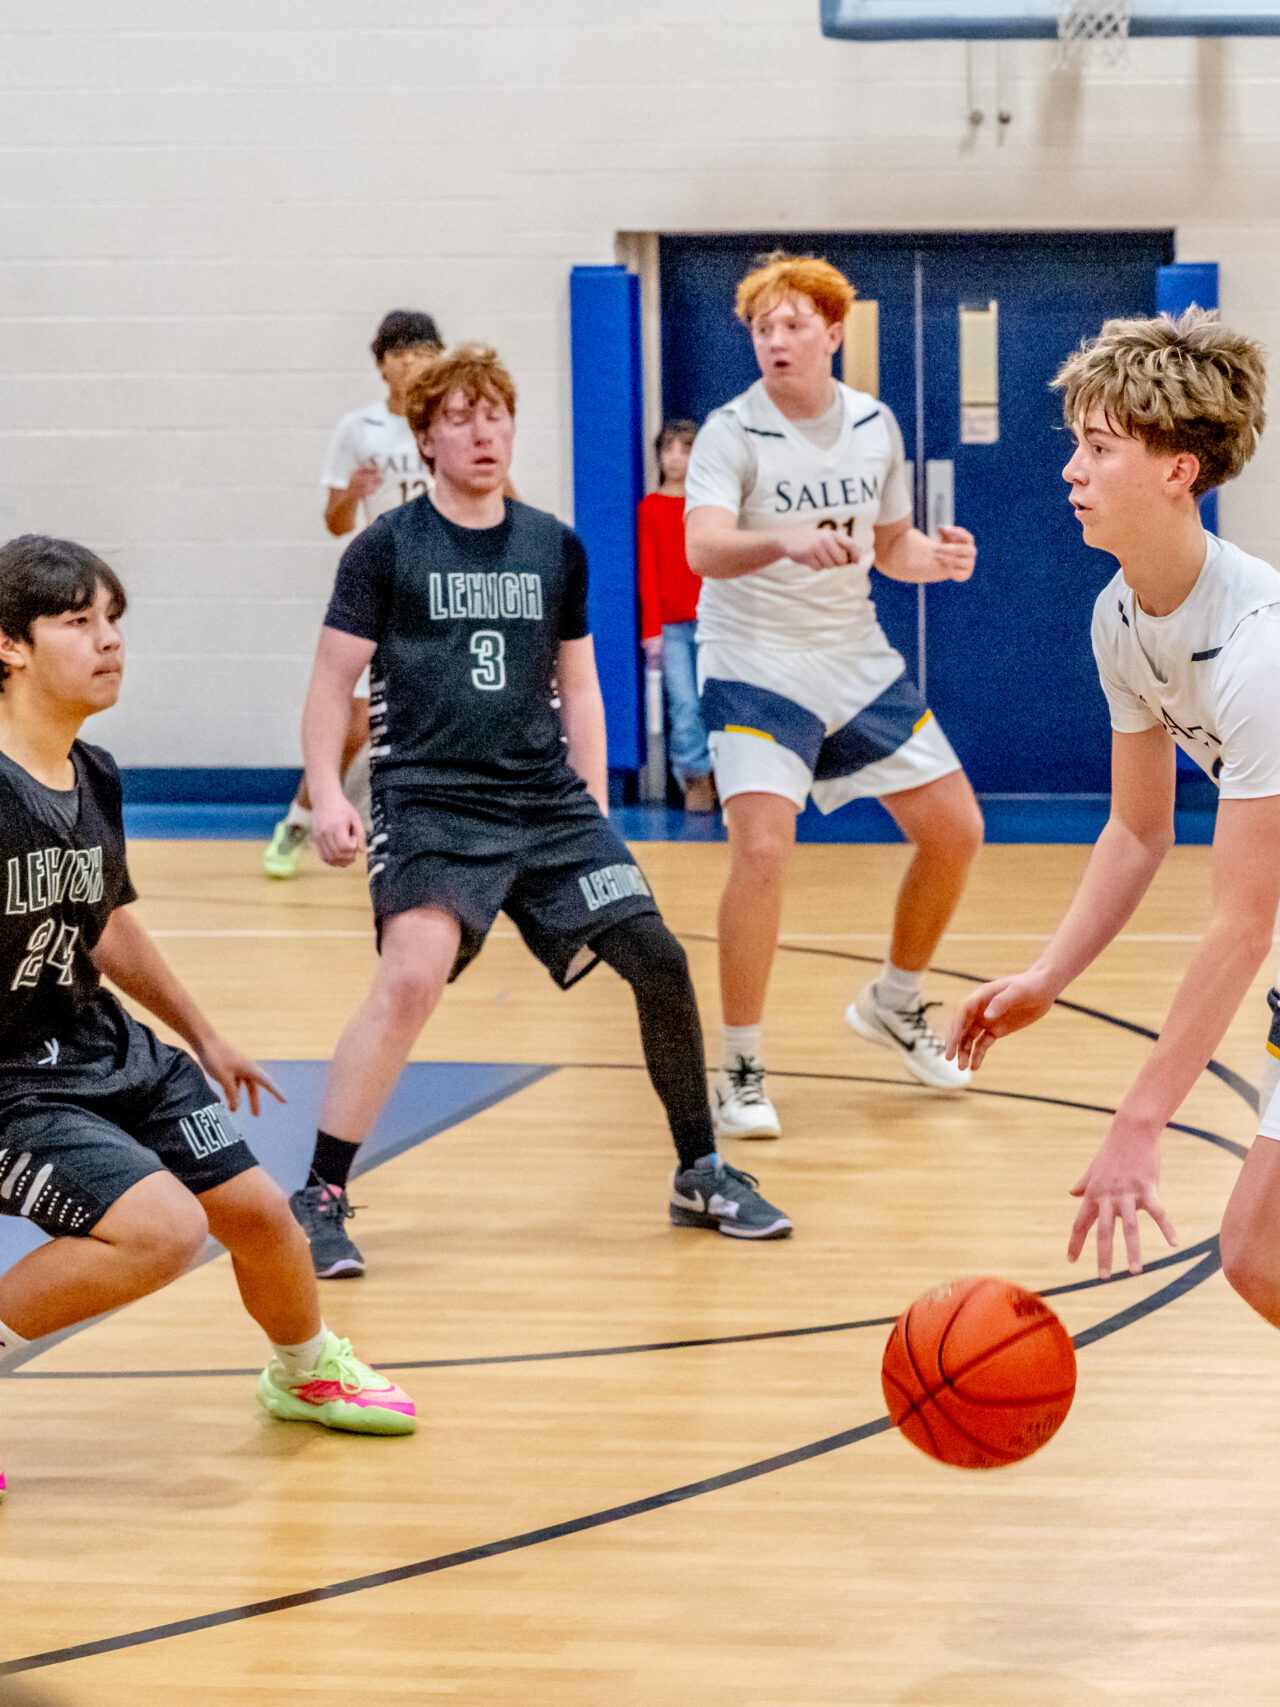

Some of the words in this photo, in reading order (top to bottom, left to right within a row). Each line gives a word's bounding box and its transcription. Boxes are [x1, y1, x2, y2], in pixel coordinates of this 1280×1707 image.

[775, 476, 880, 513] SALEM
[428, 572, 543, 621] LEHIGH
[469, 630, 506, 691] 3
[5, 846, 104, 916] LEHIGH
[10, 917, 80, 991] 24
[179, 1101, 242, 1160] LEH
